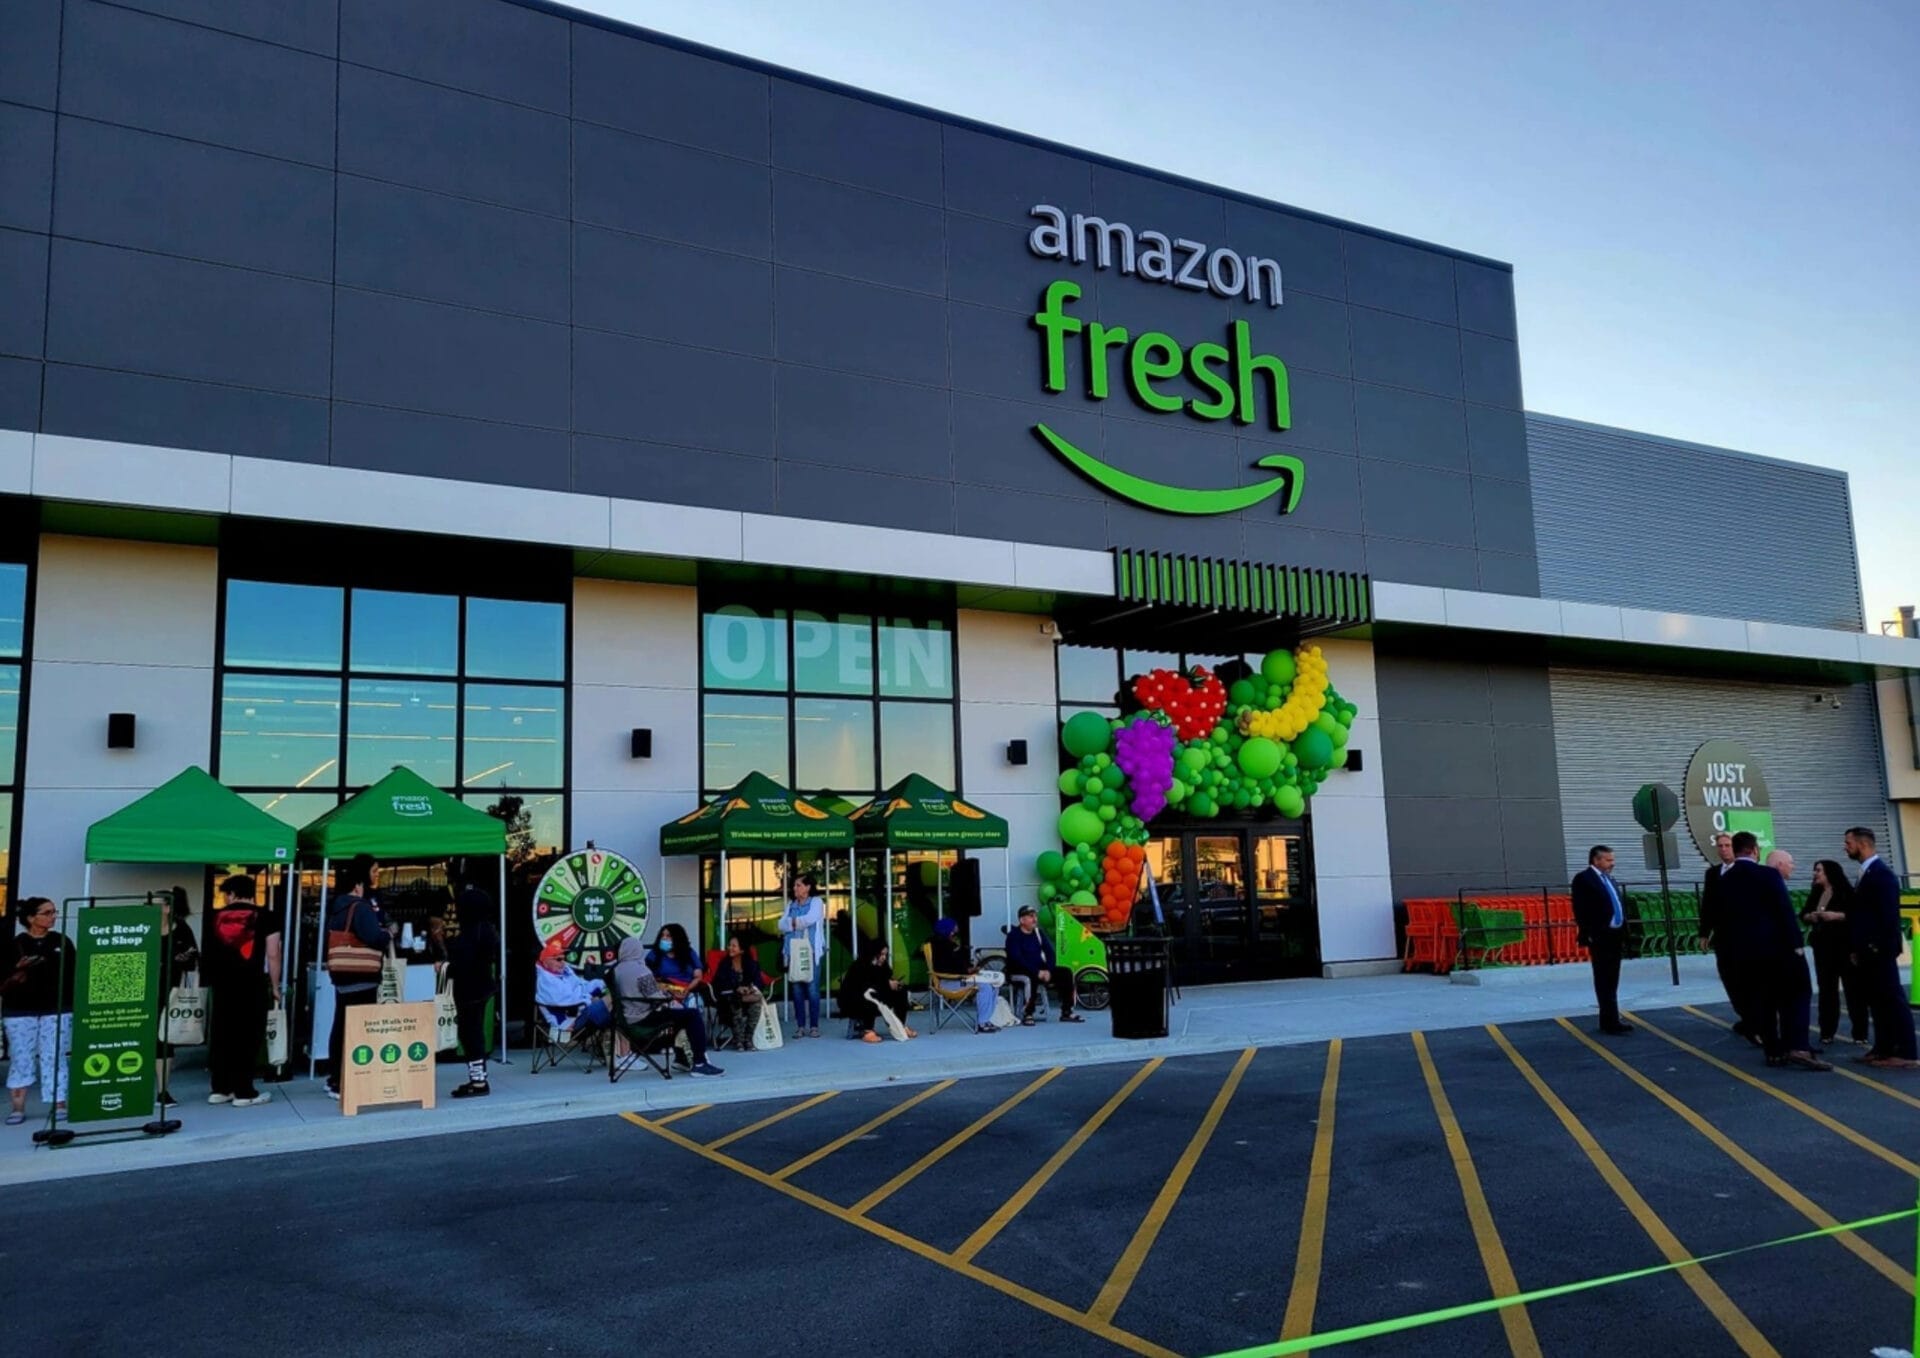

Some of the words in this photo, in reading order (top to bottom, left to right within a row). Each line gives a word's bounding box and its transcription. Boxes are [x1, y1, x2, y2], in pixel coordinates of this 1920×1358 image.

[1029, 204, 1283, 307] amazon
[1034, 280, 1291, 430] fresh
[708, 604, 945, 689] OPEN
[1706, 763, 1746, 784] JUST
[1702, 786, 1753, 807] WALK
[392, 801, 432, 811] fresh
[761, 803, 792, 811] fresh
[772, 831, 788, 839] your
[803, 831, 828, 839] grocery
[960, 831, 984, 839] grocery
[584, 896, 605, 906] Spin
[89, 926, 110, 935] Get
[113, 924, 151, 935] Ready
[96, 937, 110, 946] to
[111, 936, 143, 946] Shop
